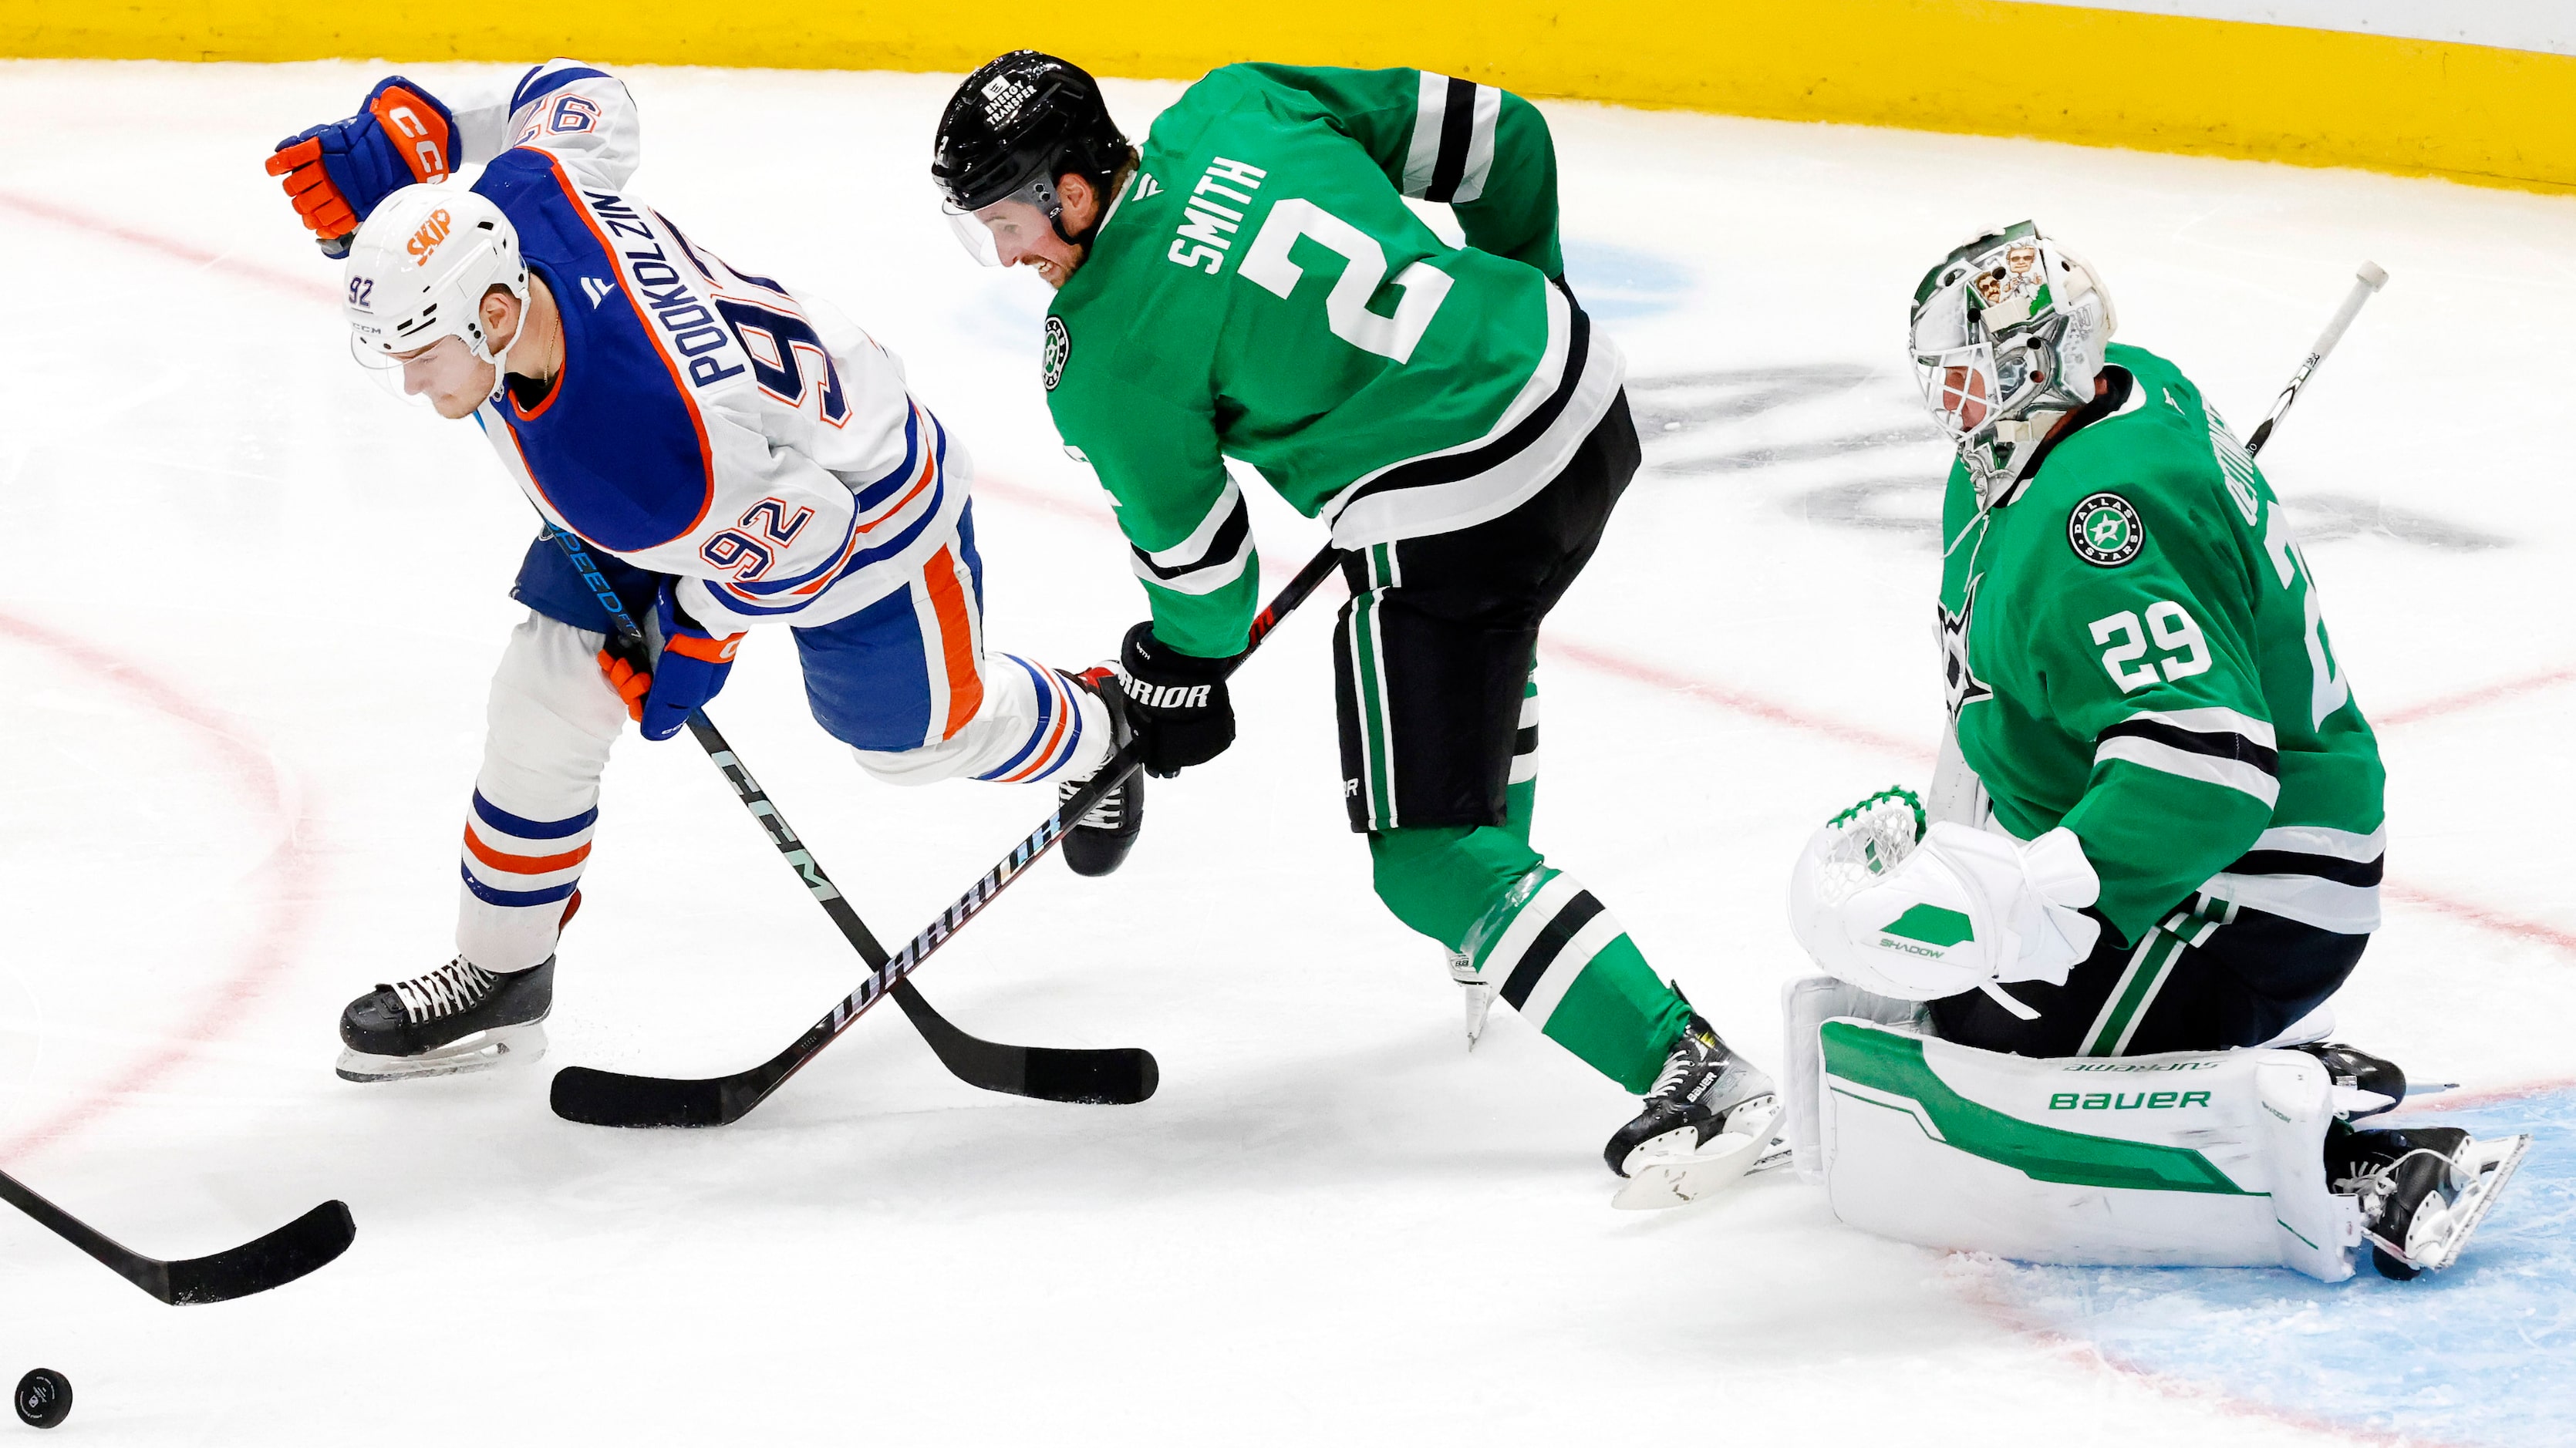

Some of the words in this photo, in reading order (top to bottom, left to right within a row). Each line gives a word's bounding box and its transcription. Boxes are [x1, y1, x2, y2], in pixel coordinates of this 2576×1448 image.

[984, 79, 1023, 115] ENERGY
[986, 85, 1037, 125] TRANSFER
[1167, 156, 1267, 275] SMITH
[406, 208, 450, 267] SKIP
[349, 274, 375, 308] 92
[582, 190, 746, 388] PODKOLZIN
[1236, 197, 1455, 365] 2
[352, 322, 381, 334] CCM
[2074, 498, 2133, 534] DALLAS
[700, 496, 815, 582] 92
[2085, 534, 2139, 561] STARS
[2087, 600, 2213, 695] 29
[710, 749, 841, 903] CCM
[1879, 938, 1946, 959] SHADOW
[1686, 1071, 1718, 1103] BAUER
[2049, 1090, 2212, 1110] BAUER
